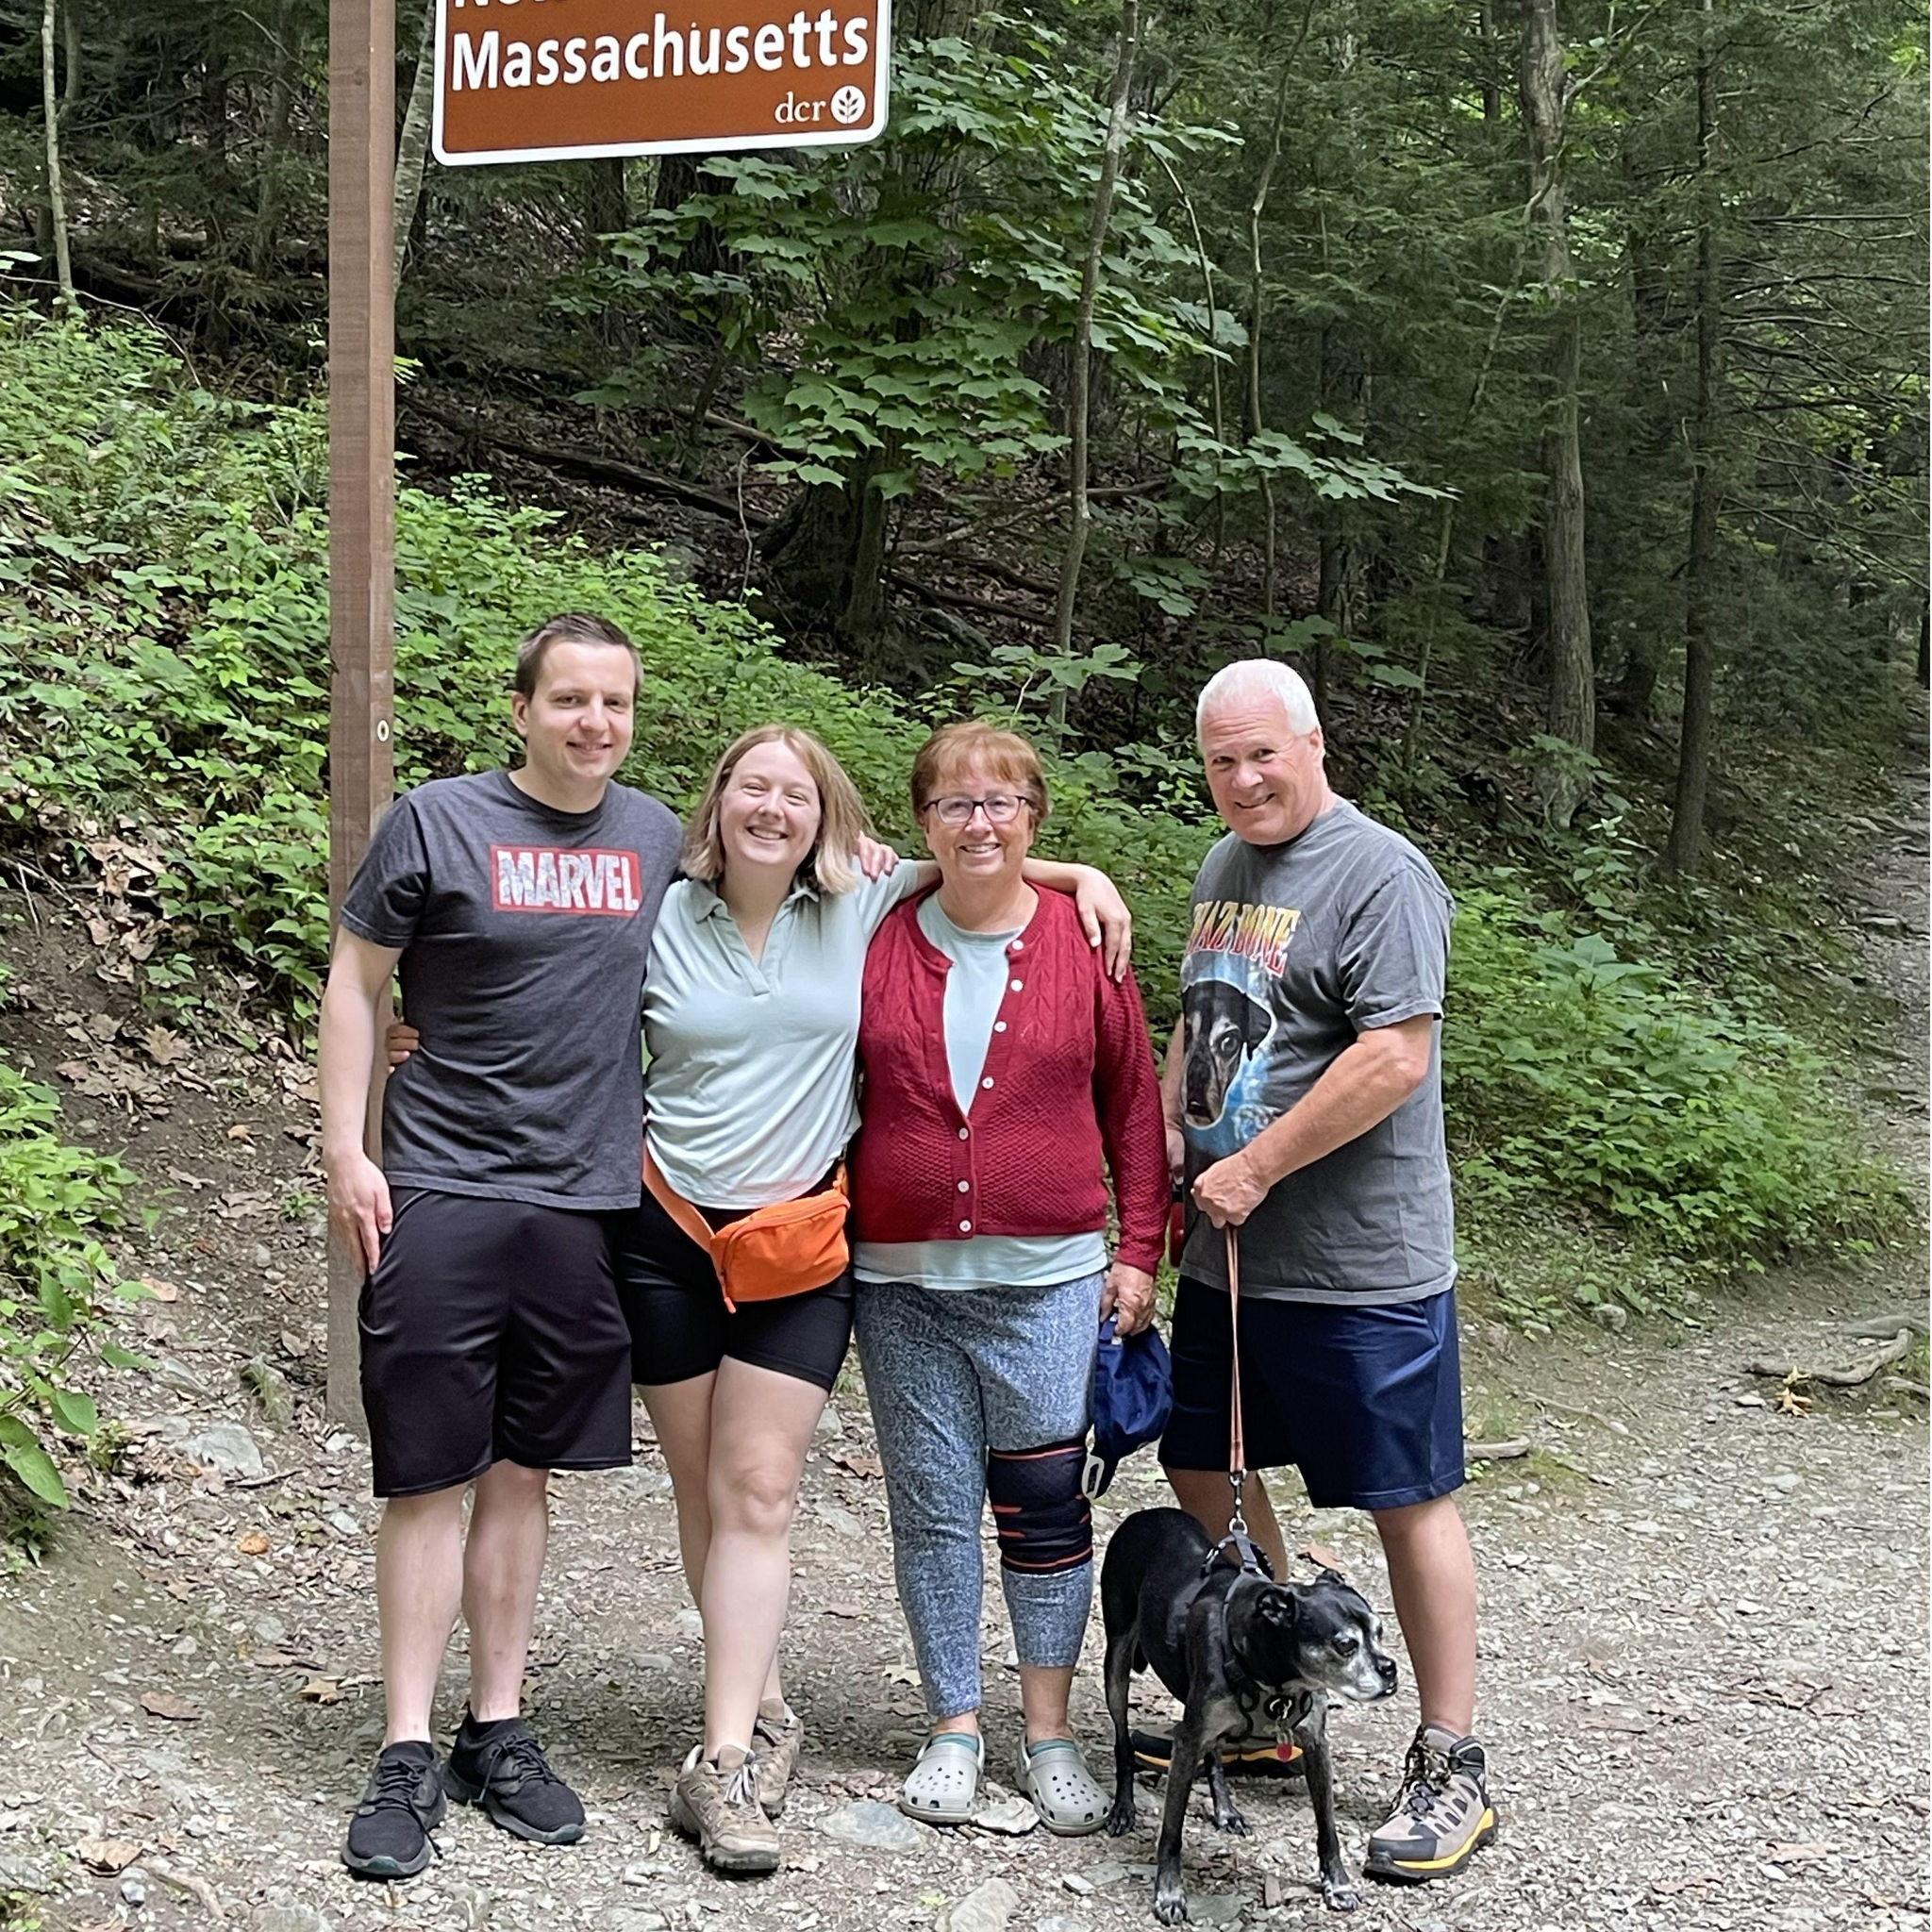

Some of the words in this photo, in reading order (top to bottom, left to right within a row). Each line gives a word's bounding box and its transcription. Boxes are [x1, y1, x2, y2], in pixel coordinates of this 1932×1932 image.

[452, 9, 868, 91] Massachusetts
[774, 91, 826, 124] dcr
[496, 850, 640, 910] MARVEL
